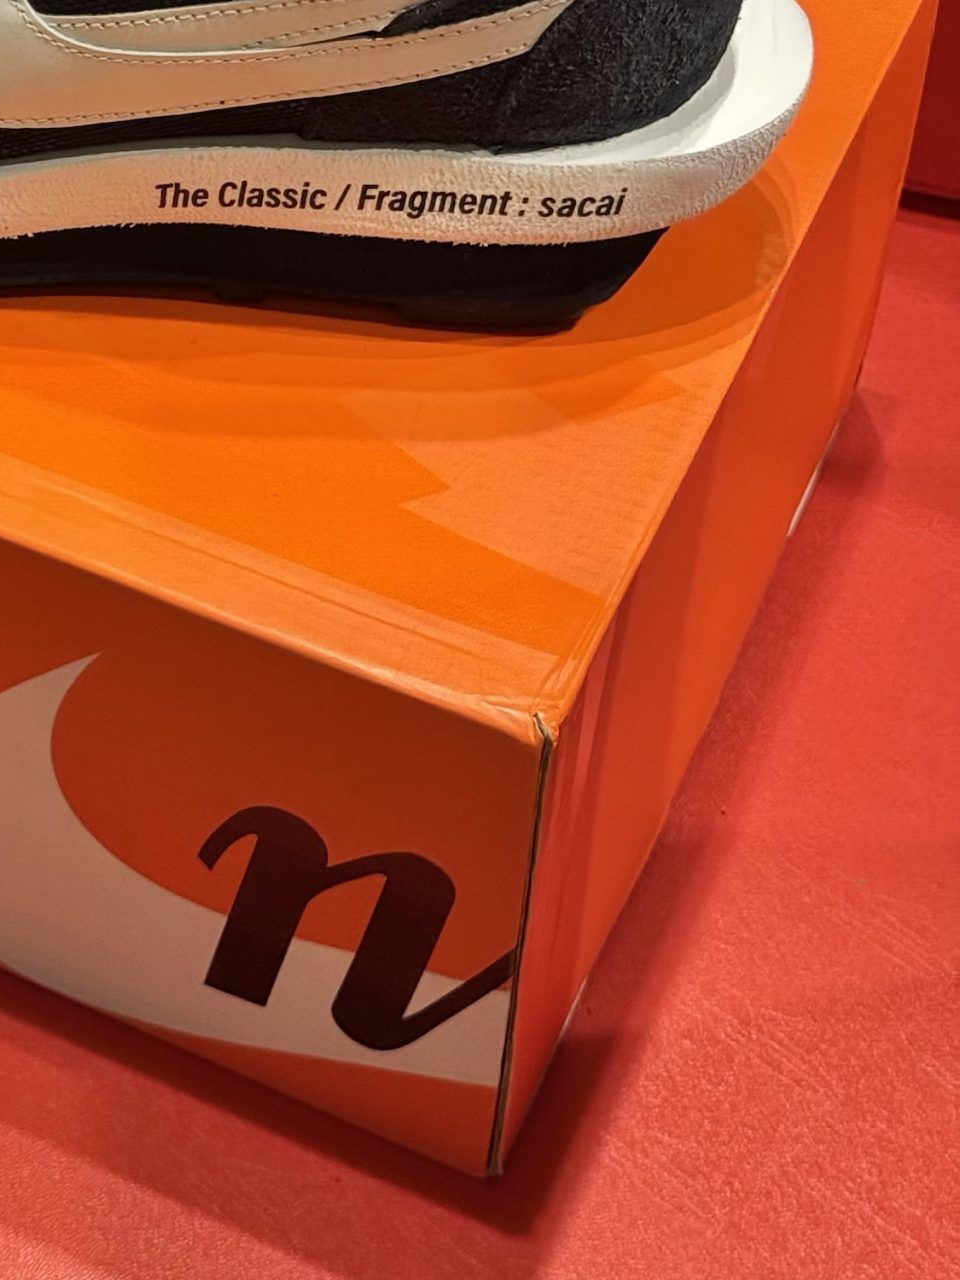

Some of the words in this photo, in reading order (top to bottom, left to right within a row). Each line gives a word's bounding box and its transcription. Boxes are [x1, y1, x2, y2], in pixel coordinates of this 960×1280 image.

[156, 184, 209, 208] The
[218, 183, 327, 211] Classic
[335, 184, 352, 211] /
[357, 184, 512, 219] Fragment
[538, 188, 627, 218] sacai
